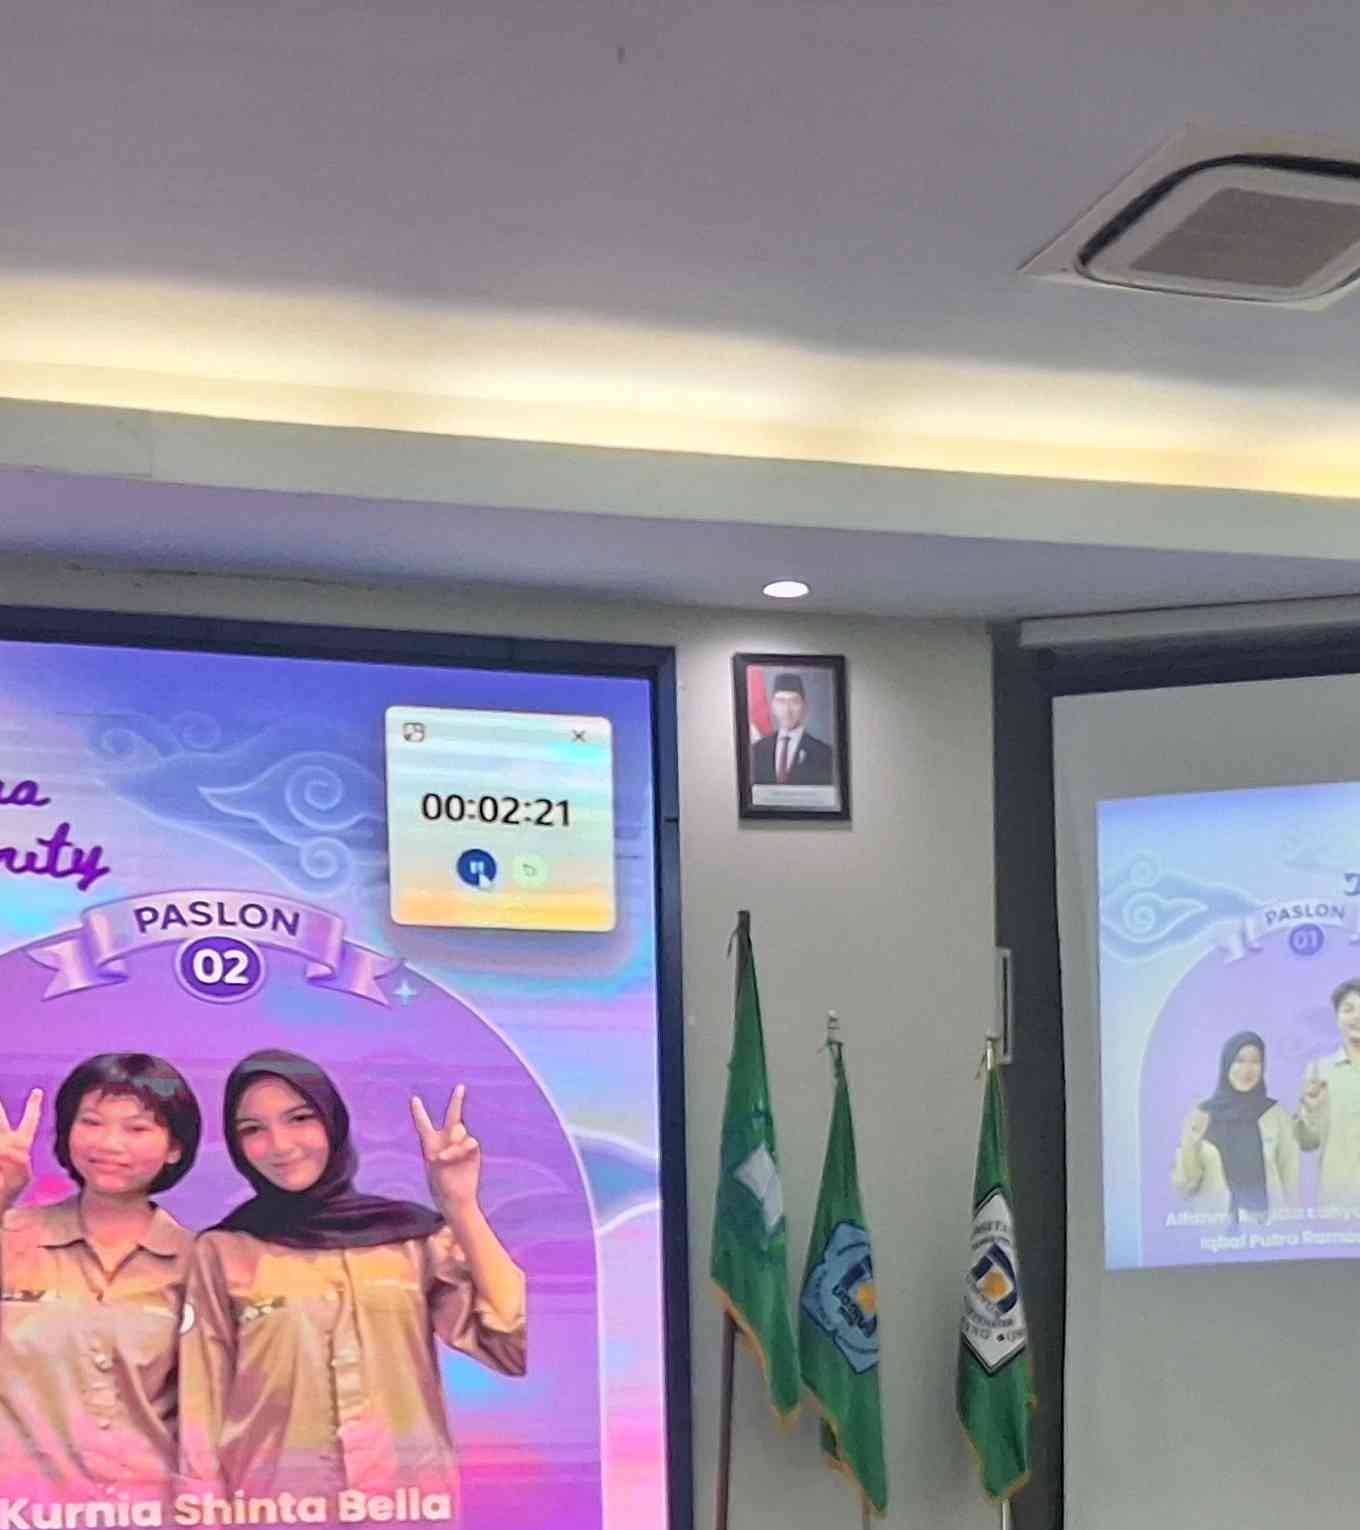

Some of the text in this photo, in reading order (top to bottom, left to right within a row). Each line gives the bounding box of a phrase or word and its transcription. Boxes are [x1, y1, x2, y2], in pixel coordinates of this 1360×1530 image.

[421, 792, 571, 827] 00:02:21
[133, 900, 300, 936] PASLON
[1264, 902, 1345, 925] PASLON
[1293, 929, 1319, 950] 01
[192, 949, 250, 984] 02
[175, 1490, 327, 1526] Shinta
[338, 1487, 451, 1522] Bella
